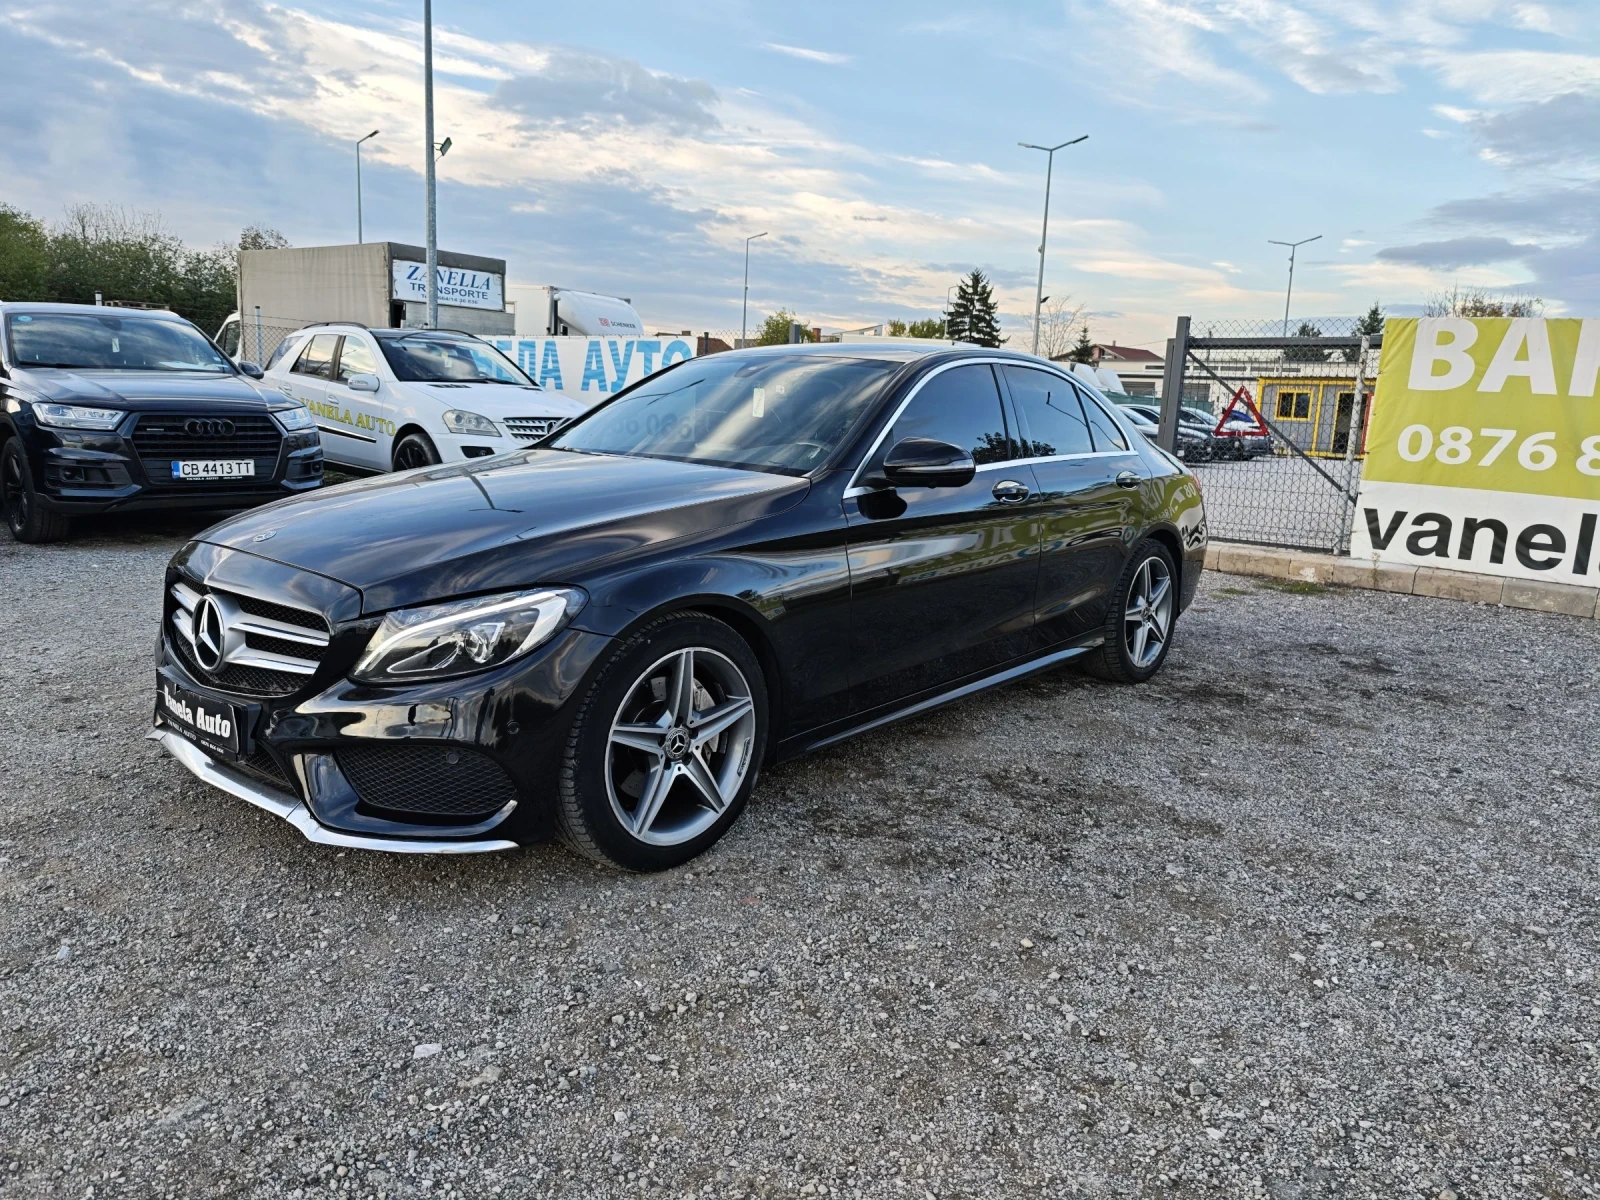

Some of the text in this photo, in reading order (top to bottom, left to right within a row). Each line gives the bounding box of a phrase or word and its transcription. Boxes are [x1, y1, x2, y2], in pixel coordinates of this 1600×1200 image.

[409, 282, 489, 300] TRNSPORTE
[610, 321, 636, 329] SCHENKER
[355, 412, 396, 437] AUTO
[1397, 424, 1558, 472] 0876
[182, 462, 251, 476] CB 4413 TT
[1364, 507, 1600, 576] vanel
[197, 707, 230, 737] Auto
